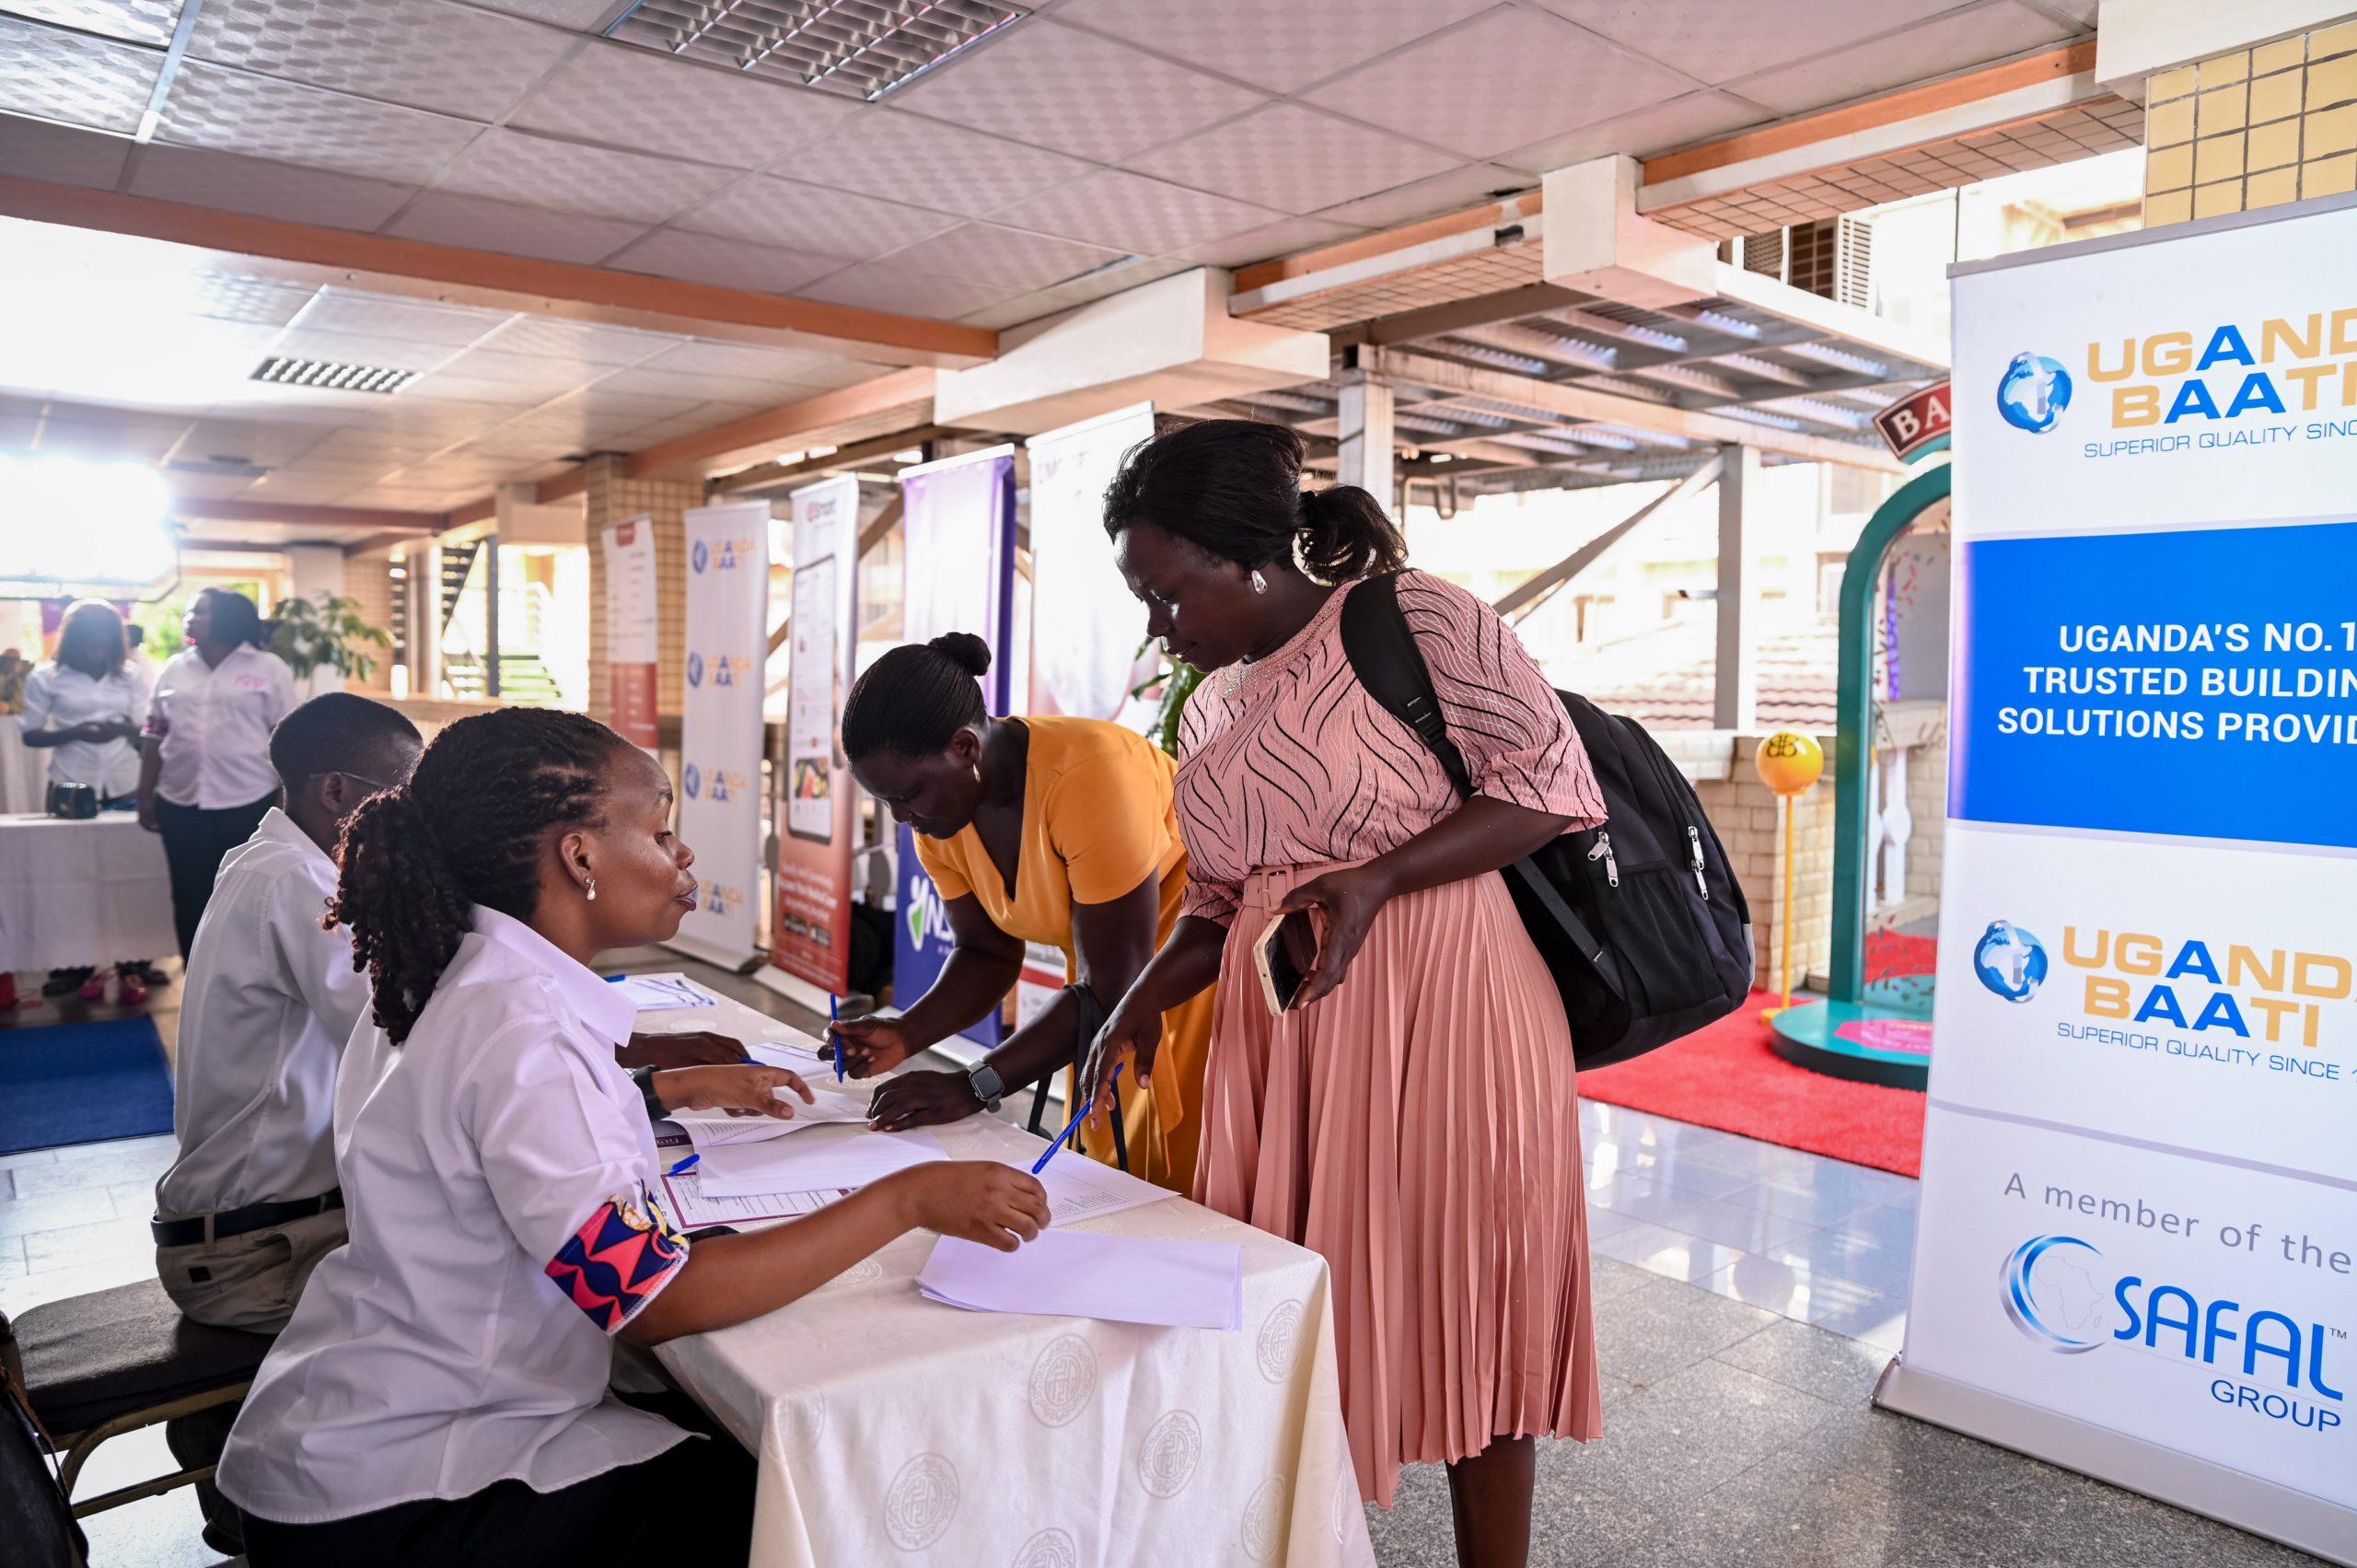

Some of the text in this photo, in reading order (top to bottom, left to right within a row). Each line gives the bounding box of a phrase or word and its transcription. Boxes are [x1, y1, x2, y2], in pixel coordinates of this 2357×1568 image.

[2111, 361, 2357, 429] BAATI
[2084, 435, 2190, 458] SUPERIOR
[2199, 425, 2297, 447] QUALITY
[2060, 621, 2356, 653] UGANDA'S NO.1
[2023, 667, 2188, 695] TRUSTED
[1997, 706, 2204, 740] SOLUTIONS
[2063, 925, 2357, 1002] UGAND
[2084, 975, 2320, 1048] BAATI
[2057, 1022, 2159, 1051] SUPERIOR
[2165, 1039, 2261, 1066] QUALITY
[2269, 1054, 2340, 1081] SINCE
[2003, 1173, 2351, 1274] A member of the
[2113, 1276, 2343, 1401] SAFAL
[2211, 1379, 2341, 1433] GROUP
